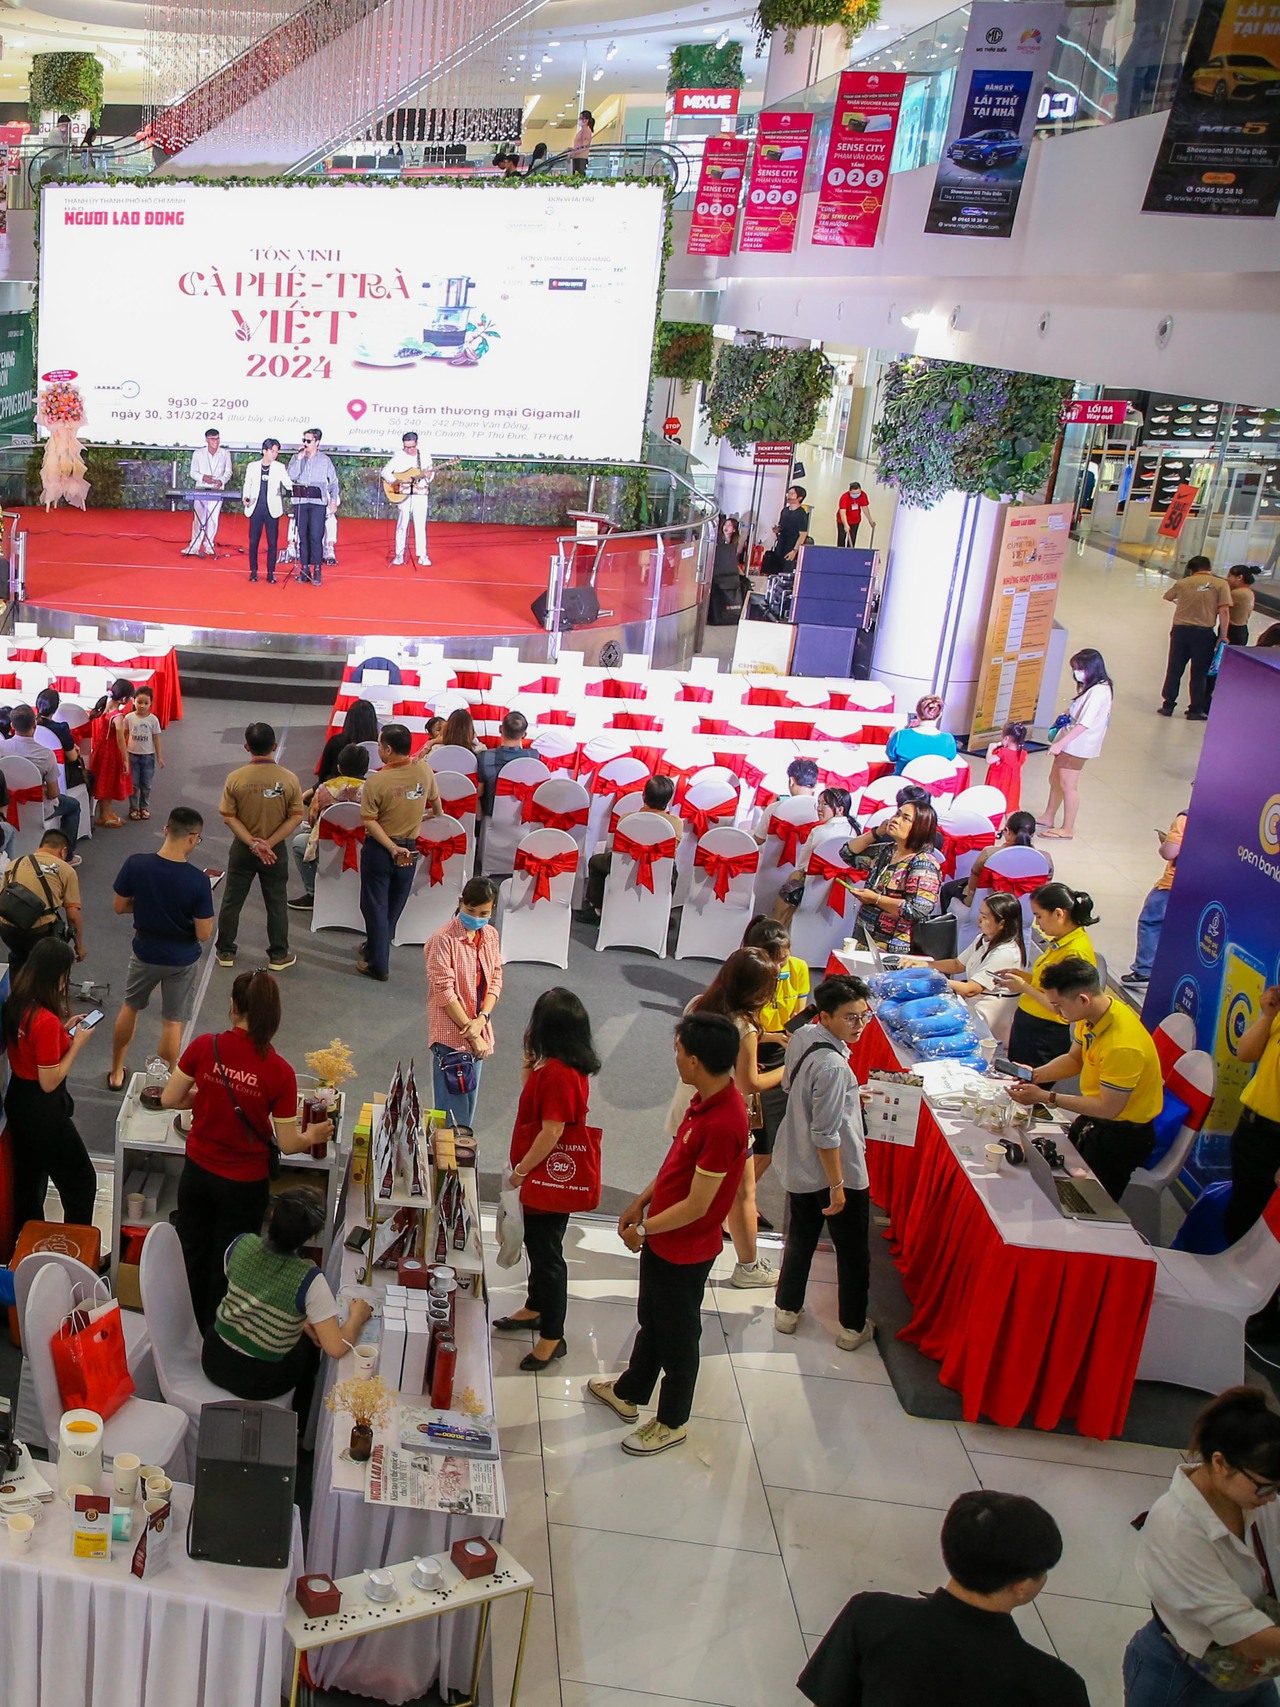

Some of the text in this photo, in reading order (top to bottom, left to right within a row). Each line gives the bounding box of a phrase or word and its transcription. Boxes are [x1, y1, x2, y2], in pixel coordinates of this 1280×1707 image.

[682, 95, 732, 110] MIXUE
[974, 95, 991, 105] LÁI
[973, 106, 1015, 118] TẠI NHÀ
[836, 143, 886, 152] SENSE CITY
[781, 169, 798, 177] CITY
[834, 172, 878, 183] 1 2 3
[113, 211, 140, 225] LAO
[297, 249, 340, 262] VINH
[178, 265, 226, 297] CÀ
[230, 299, 357, 351] VIỆT
[246, 354, 334, 379] 2024
[168, 398, 249, 409] 9g30 22g00
[1102, 405, 1113, 413] RA
[111, 410, 224, 420] ngày 30, 31/3/2024
[372, 404, 580, 419] Trung tâm thương mại Gigamall
[1086, 413, 1100, 421] Way
[404, 418, 421, 426] 240
[452, 420, 480, 429] Phạm
[1164, 511, 1183, 531] 50
[565, 1144, 587, 1152] JAPAN
